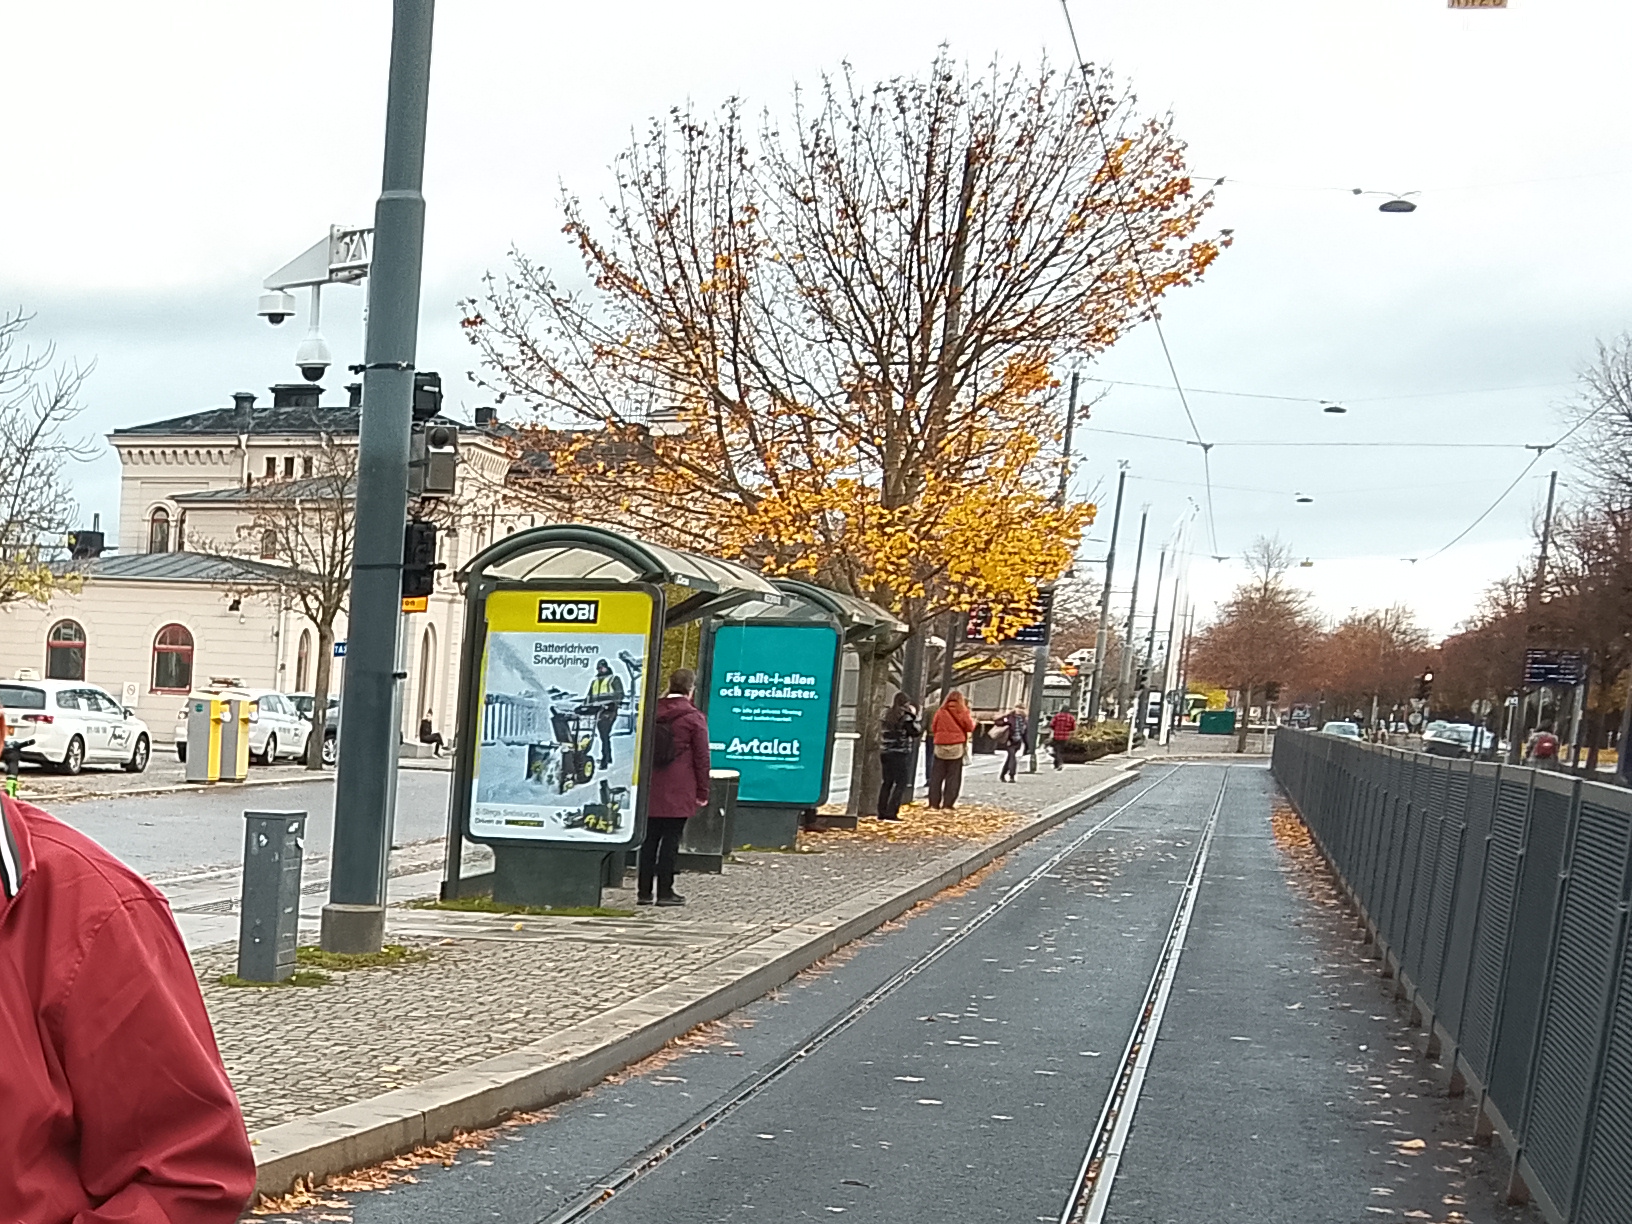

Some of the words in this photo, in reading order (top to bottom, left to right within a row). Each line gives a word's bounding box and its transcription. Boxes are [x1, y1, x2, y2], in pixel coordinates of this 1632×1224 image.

[541, 603, 596, 620] RYOBI
[334, 645, 348, 654] TAX
[534, 642, 600, 655] Batteridriven
[533, 653, 590, 669] Snöröjning
[726, 671, 747, 683] För
[719, 685, 742, 697] och
[743, 686, 819, 700] specialister.
[726, 737, 800, 755] Avtalat
